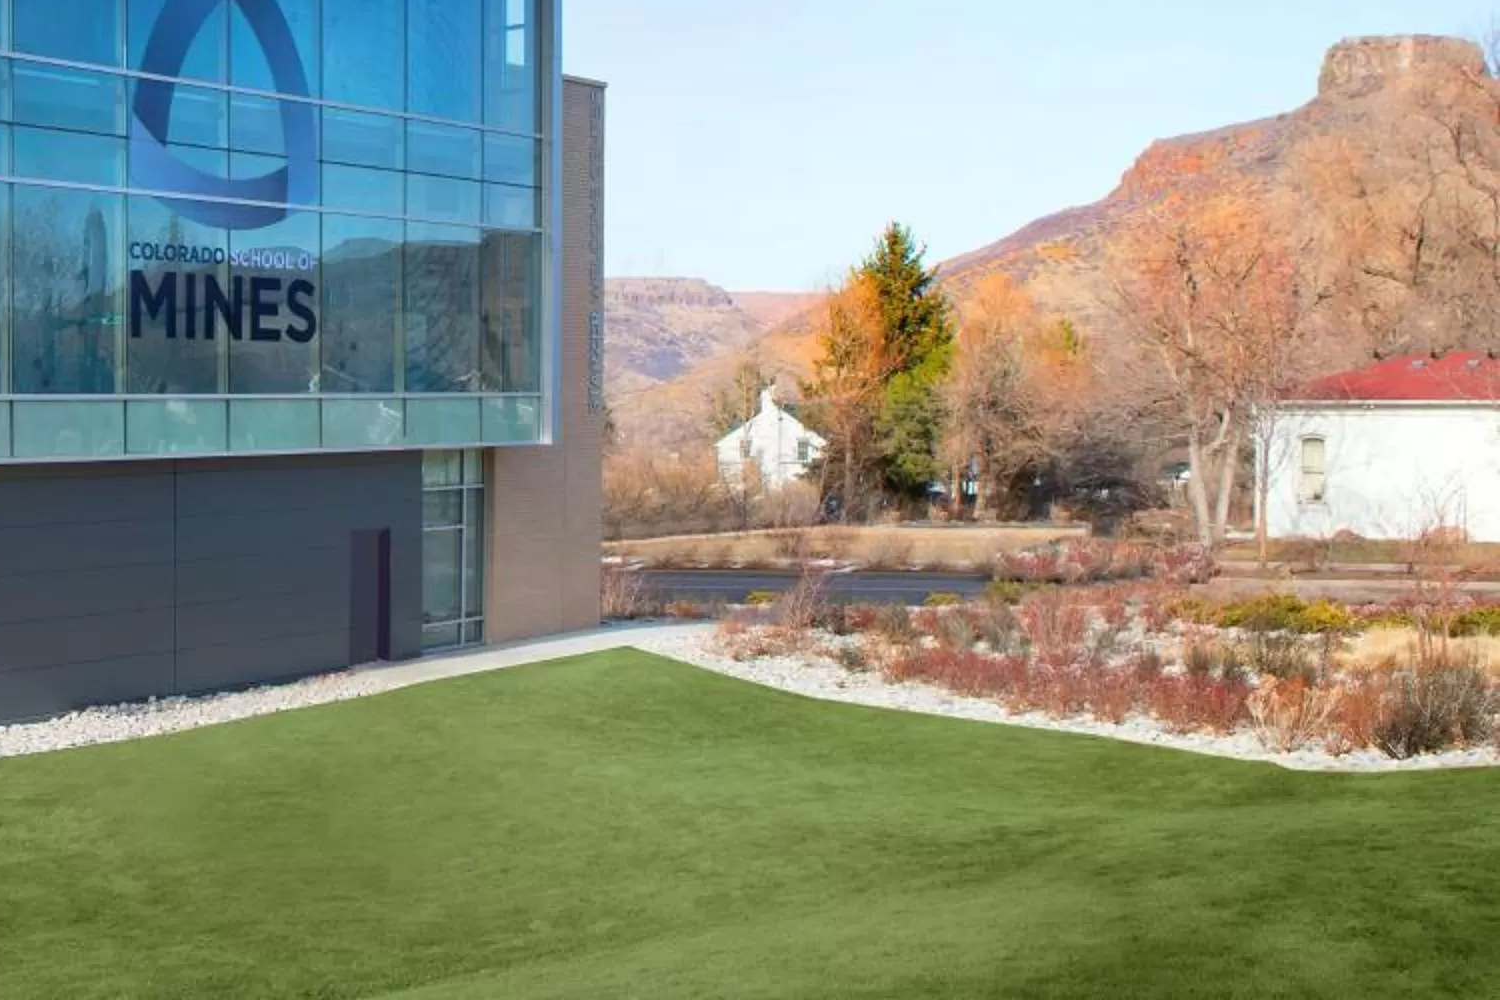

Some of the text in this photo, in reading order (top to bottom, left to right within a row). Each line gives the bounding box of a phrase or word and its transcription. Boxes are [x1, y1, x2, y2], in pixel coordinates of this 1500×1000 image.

[130, 241, 319, 273] COLORADO SCHOOL OF
[130, 269, 318, 343] MINES
